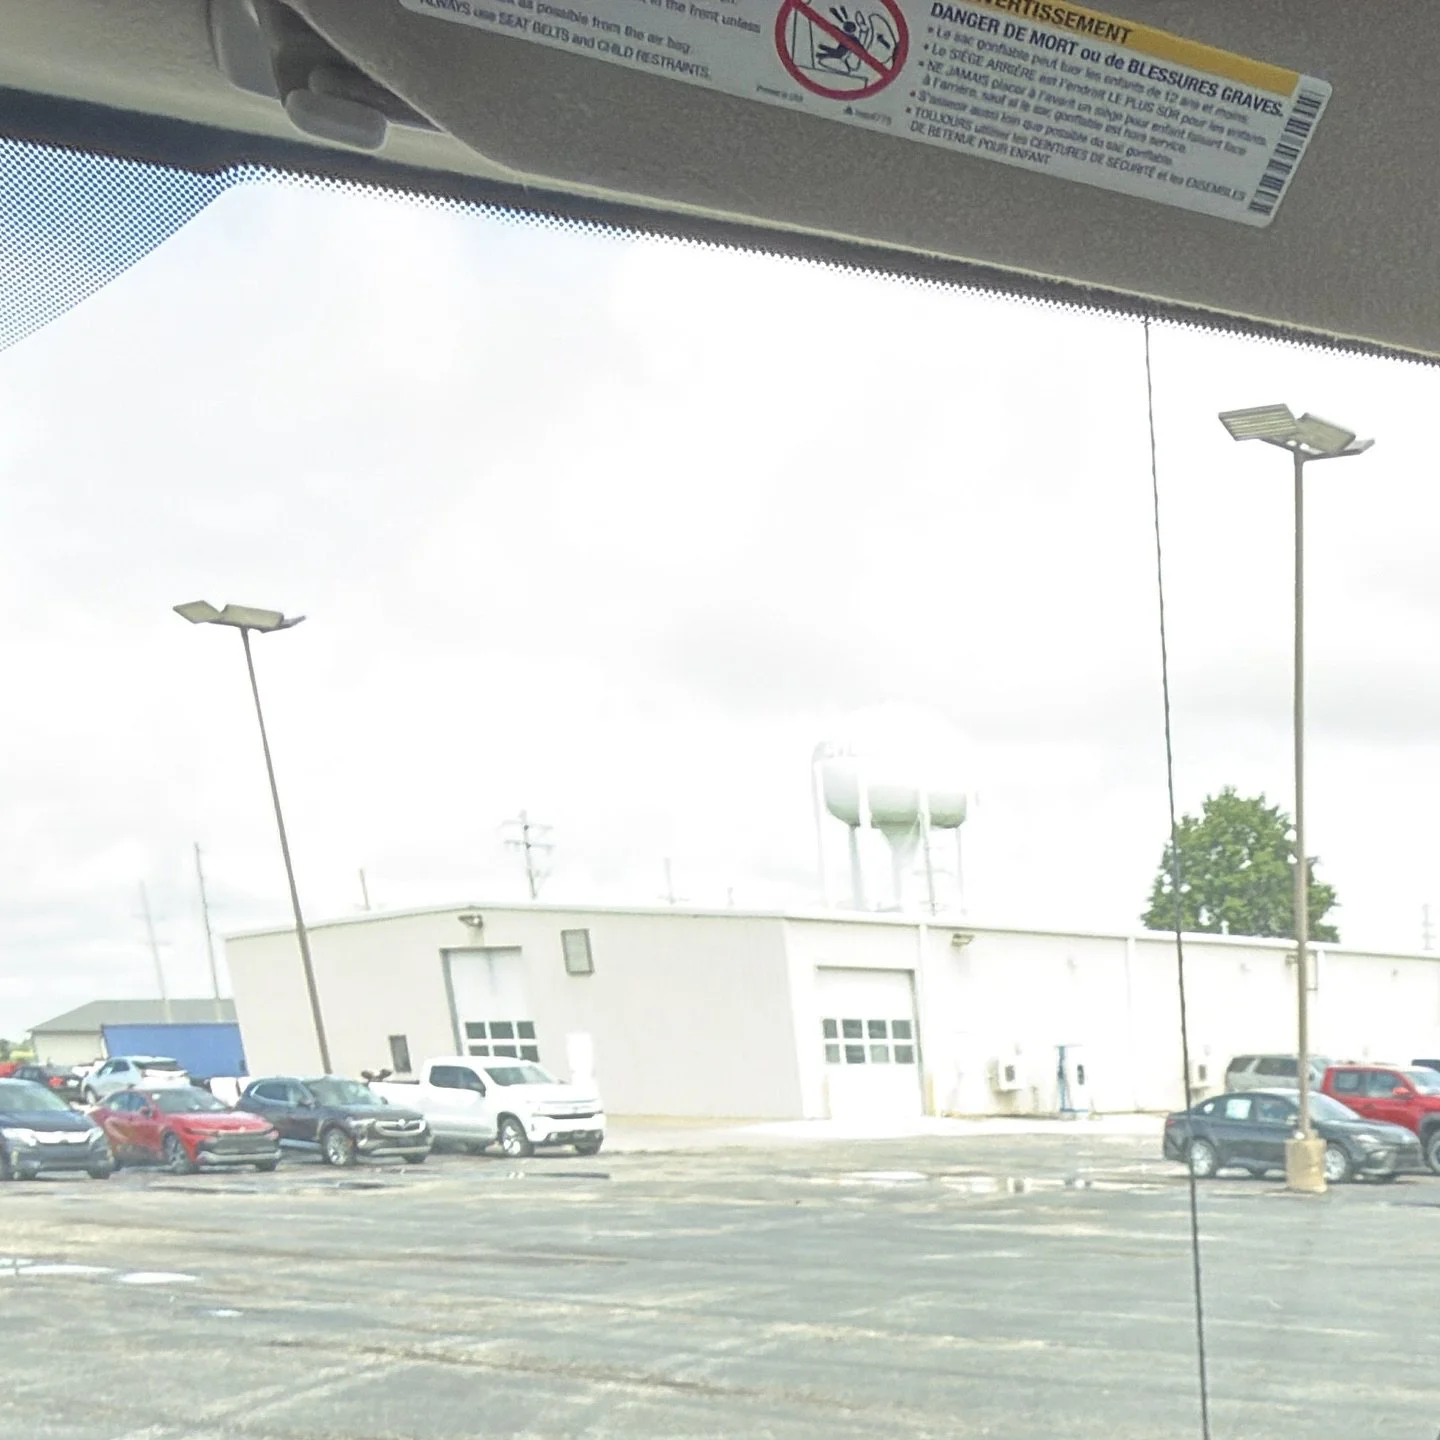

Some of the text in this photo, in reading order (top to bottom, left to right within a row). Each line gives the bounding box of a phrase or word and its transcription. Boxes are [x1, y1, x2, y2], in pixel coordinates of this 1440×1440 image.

[931, 2, 1284, 117] DANGER DE MORT ou de BLESSURES GRAVES.
